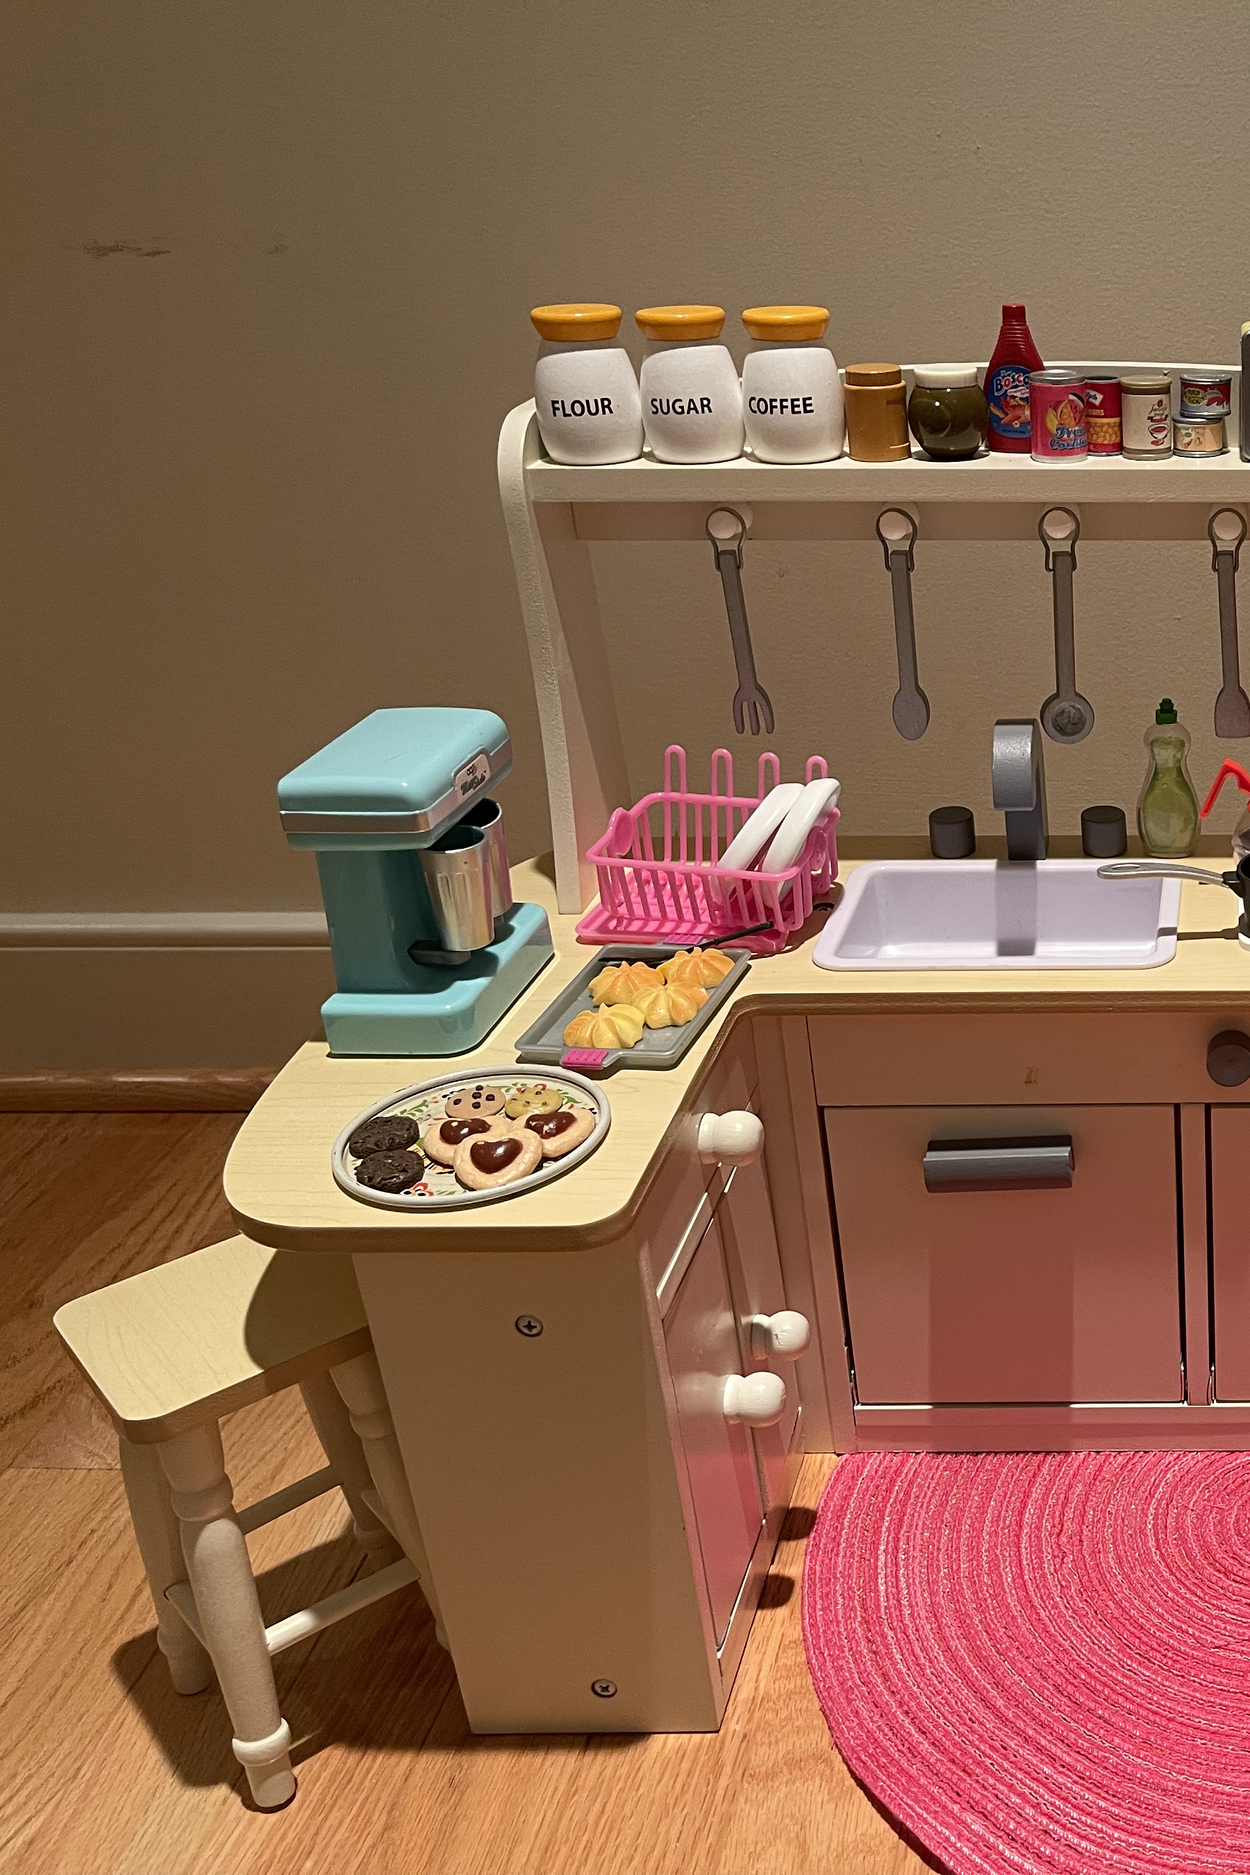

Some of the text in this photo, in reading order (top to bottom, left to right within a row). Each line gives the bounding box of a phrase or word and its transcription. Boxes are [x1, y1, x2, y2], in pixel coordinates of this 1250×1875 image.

[551, 397, 613, 417] FLOUR
[650, 397, 713, 416] SUGAR
[748, 396, 815, 415] COFFEE
